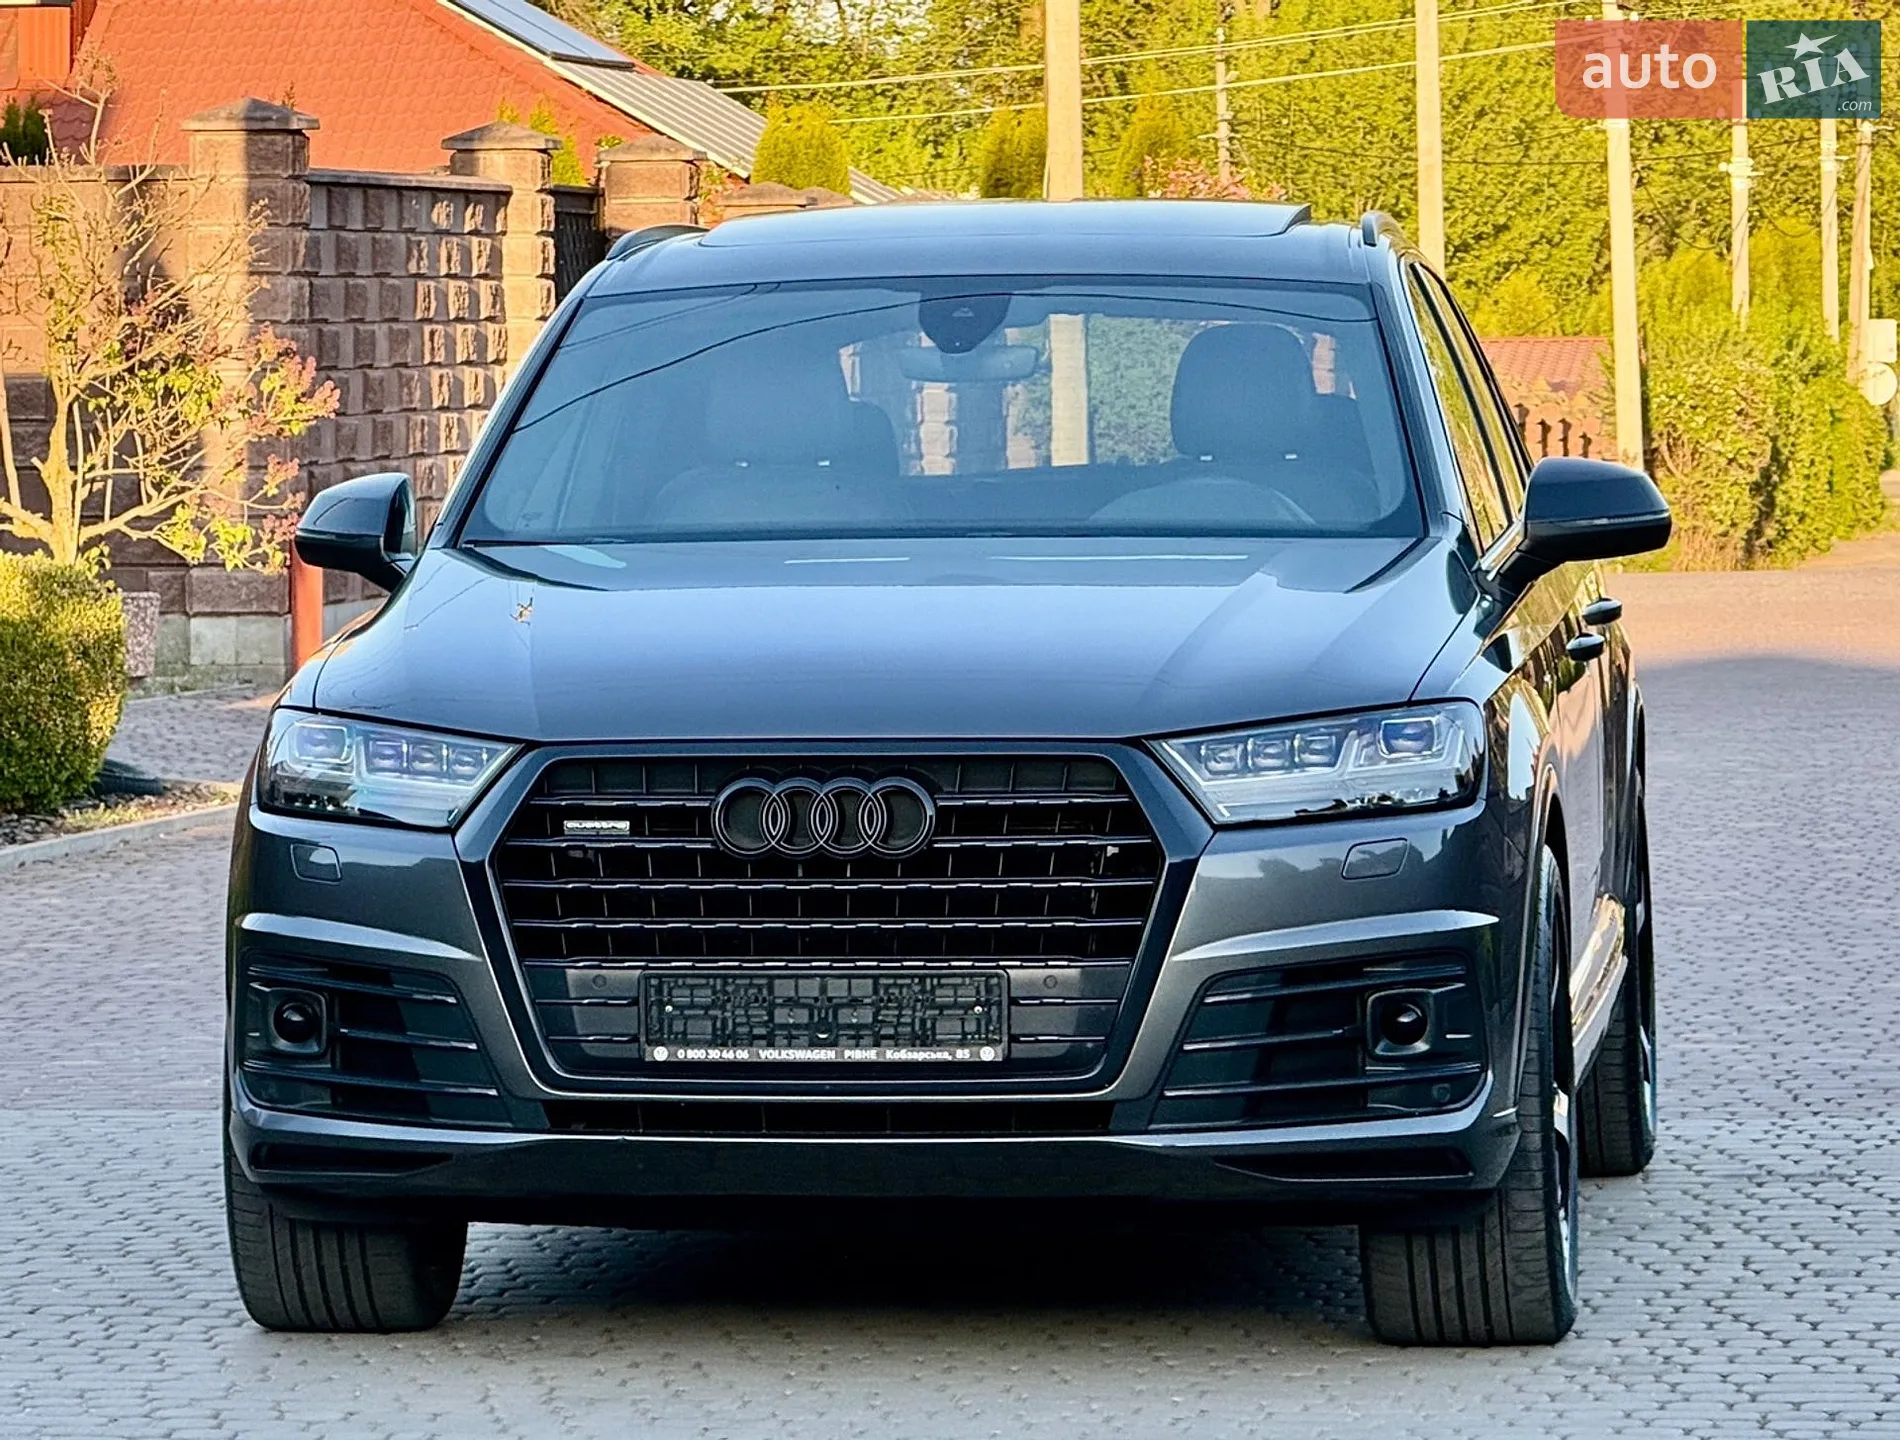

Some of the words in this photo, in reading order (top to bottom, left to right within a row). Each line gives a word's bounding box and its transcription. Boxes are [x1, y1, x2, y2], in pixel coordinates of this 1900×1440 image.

[677, 1049, 686, 1059] 0
[687, 1049, 707, 1059] 800
[708, 1049, 721, 1059] 30
[736, 1049, 750, 1059] 06
[759, 1049, 836, 1059] VOLKSWAGEN
